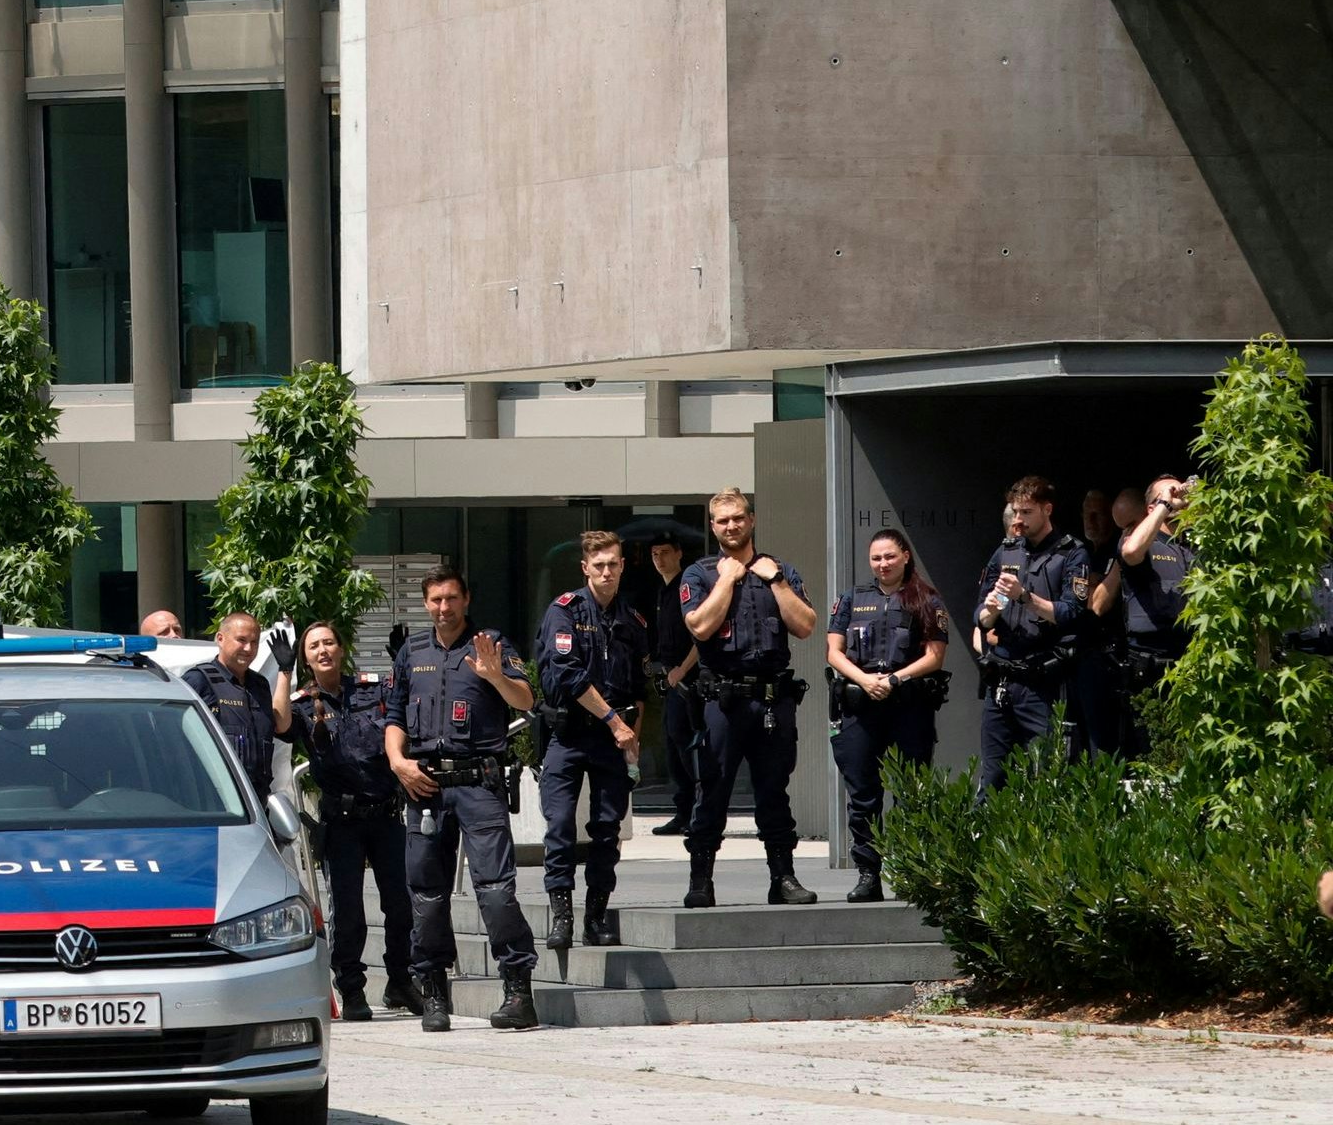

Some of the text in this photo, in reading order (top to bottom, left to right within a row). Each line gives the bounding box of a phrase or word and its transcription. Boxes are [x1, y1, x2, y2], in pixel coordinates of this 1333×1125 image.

[859, 509, 978, 527] HELMUT
[413, 665, 437, 673] POLIZEI
[6, 1019, 14, 1028] A
[74, 1001, 146, 1026] 61052
